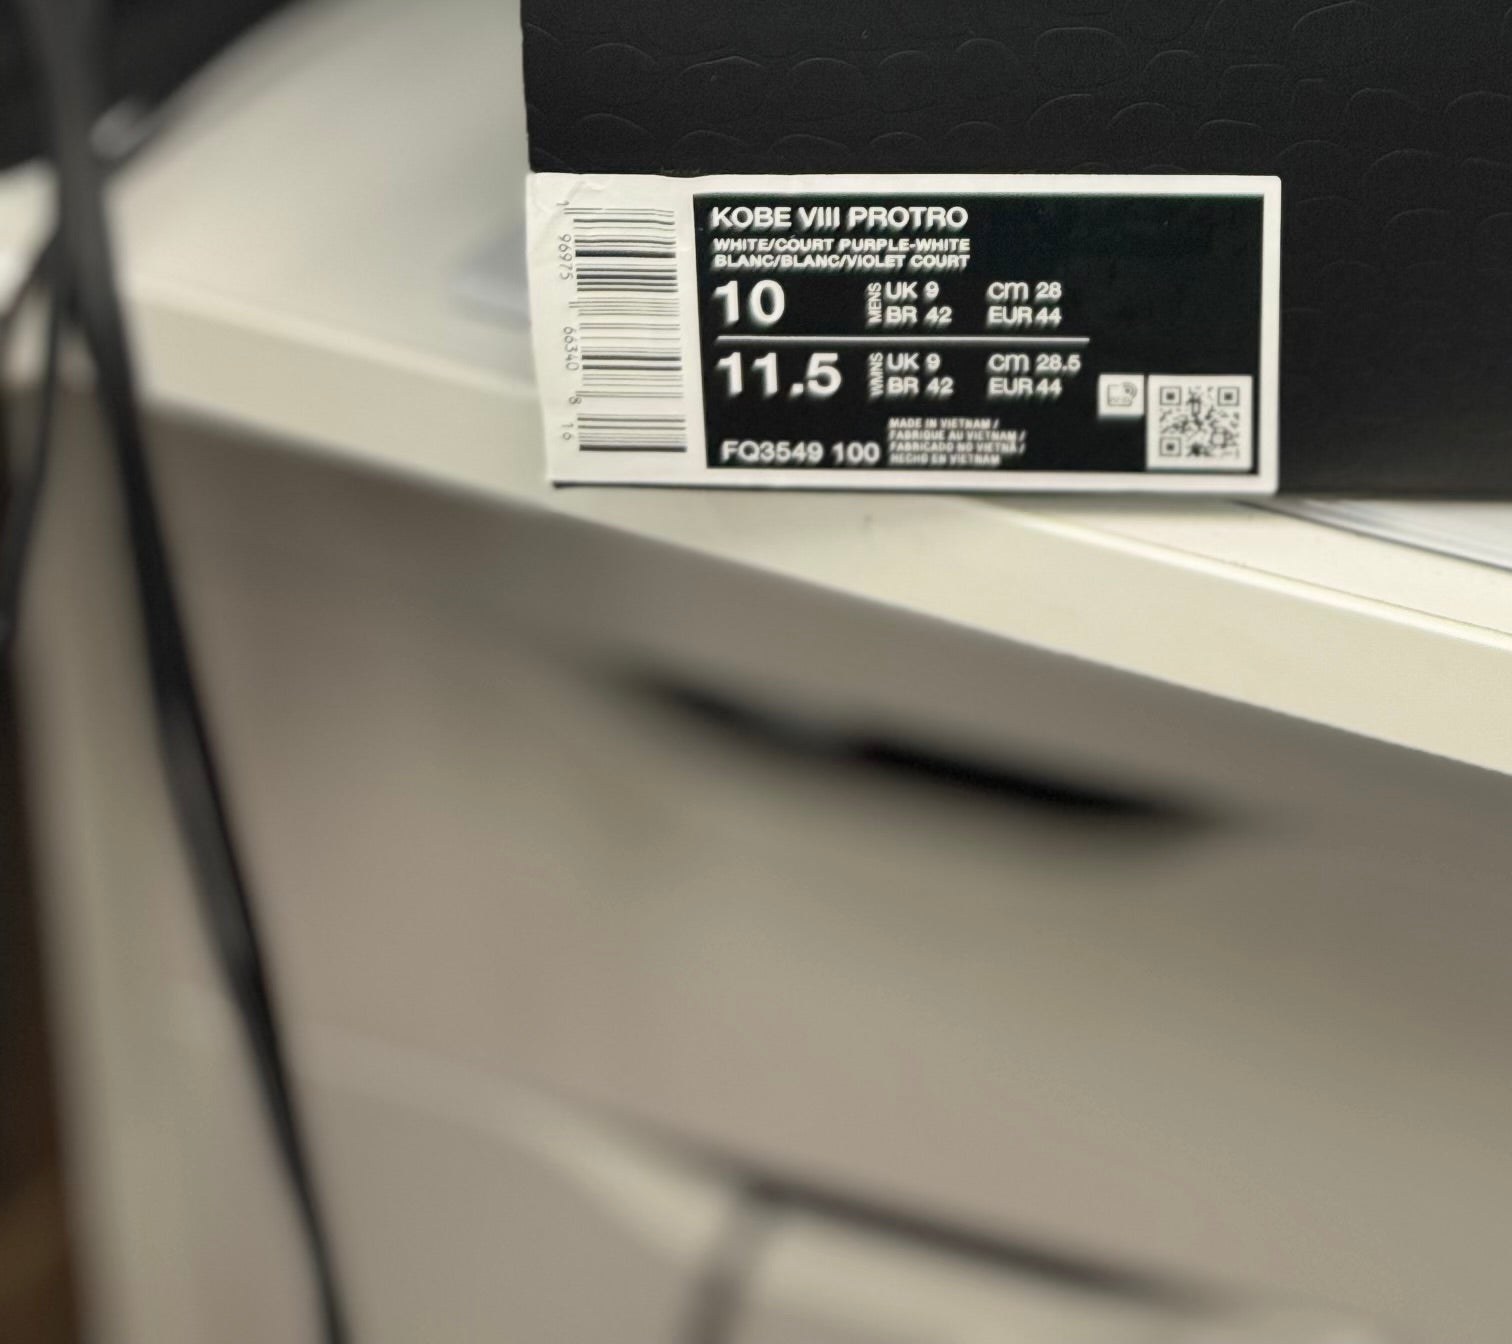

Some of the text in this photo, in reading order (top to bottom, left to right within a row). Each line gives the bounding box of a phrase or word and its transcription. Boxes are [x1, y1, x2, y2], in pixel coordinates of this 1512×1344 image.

[711, 206, 969, 229] KOBE VIII PROTRO
[713, 237, 971, 253] WHITE/COURT PURPLE-WHITE
[557, 233, 574, 281] 96975
[713, 254, 971, 269] BLANC/BLANC/VIOLET COURT
[884, 280, 940, 300] UK 9
[1034, 281, 1063, 300] 28
[713, 278, 786, 327] 10
[866, 281, 882, 324] MENS
[885, 305, 953, 325] BR 42
[988, 305, 1063, 326] EUR 44
[886, 352, 941, 371] UK 9
[1035, 353, 1082, 372] 28.5
[715, 351, 843, 399] 11.5
[887, 376, 954, 395] BR 42
[988, 376, 1063, 396] EUR 44
[888, 417, 923, 430] MADE
[924, 417, 938, 430] IN
[939, 417, 992, 430] VIETNAM
[720, 439, 882, 464] FQ3549 100
